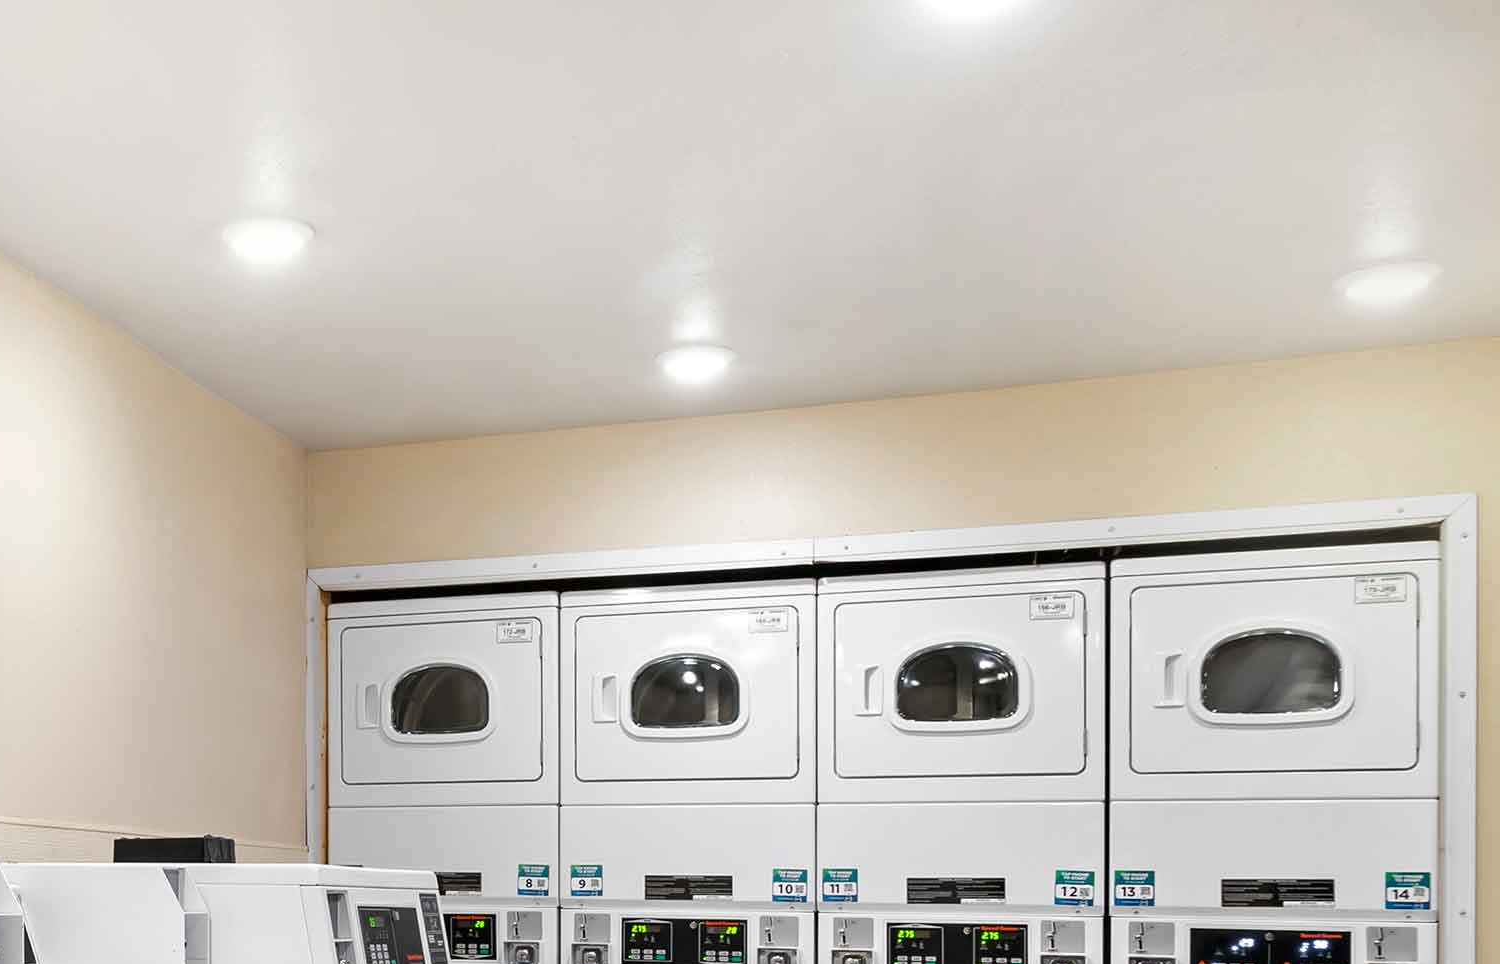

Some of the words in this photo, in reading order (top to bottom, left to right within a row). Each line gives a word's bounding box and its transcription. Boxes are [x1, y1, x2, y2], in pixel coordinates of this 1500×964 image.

[525, 878, 533, 888] 8
[578, 879, 586, 889] 9
[778, 883, 793, 894] 10
[830, 884, 840, 893] 11
[1061, 886, 1078, 896] 12
[1121, 886, 1136, 897] 13
[1392, 889, 1410, 900] 14
